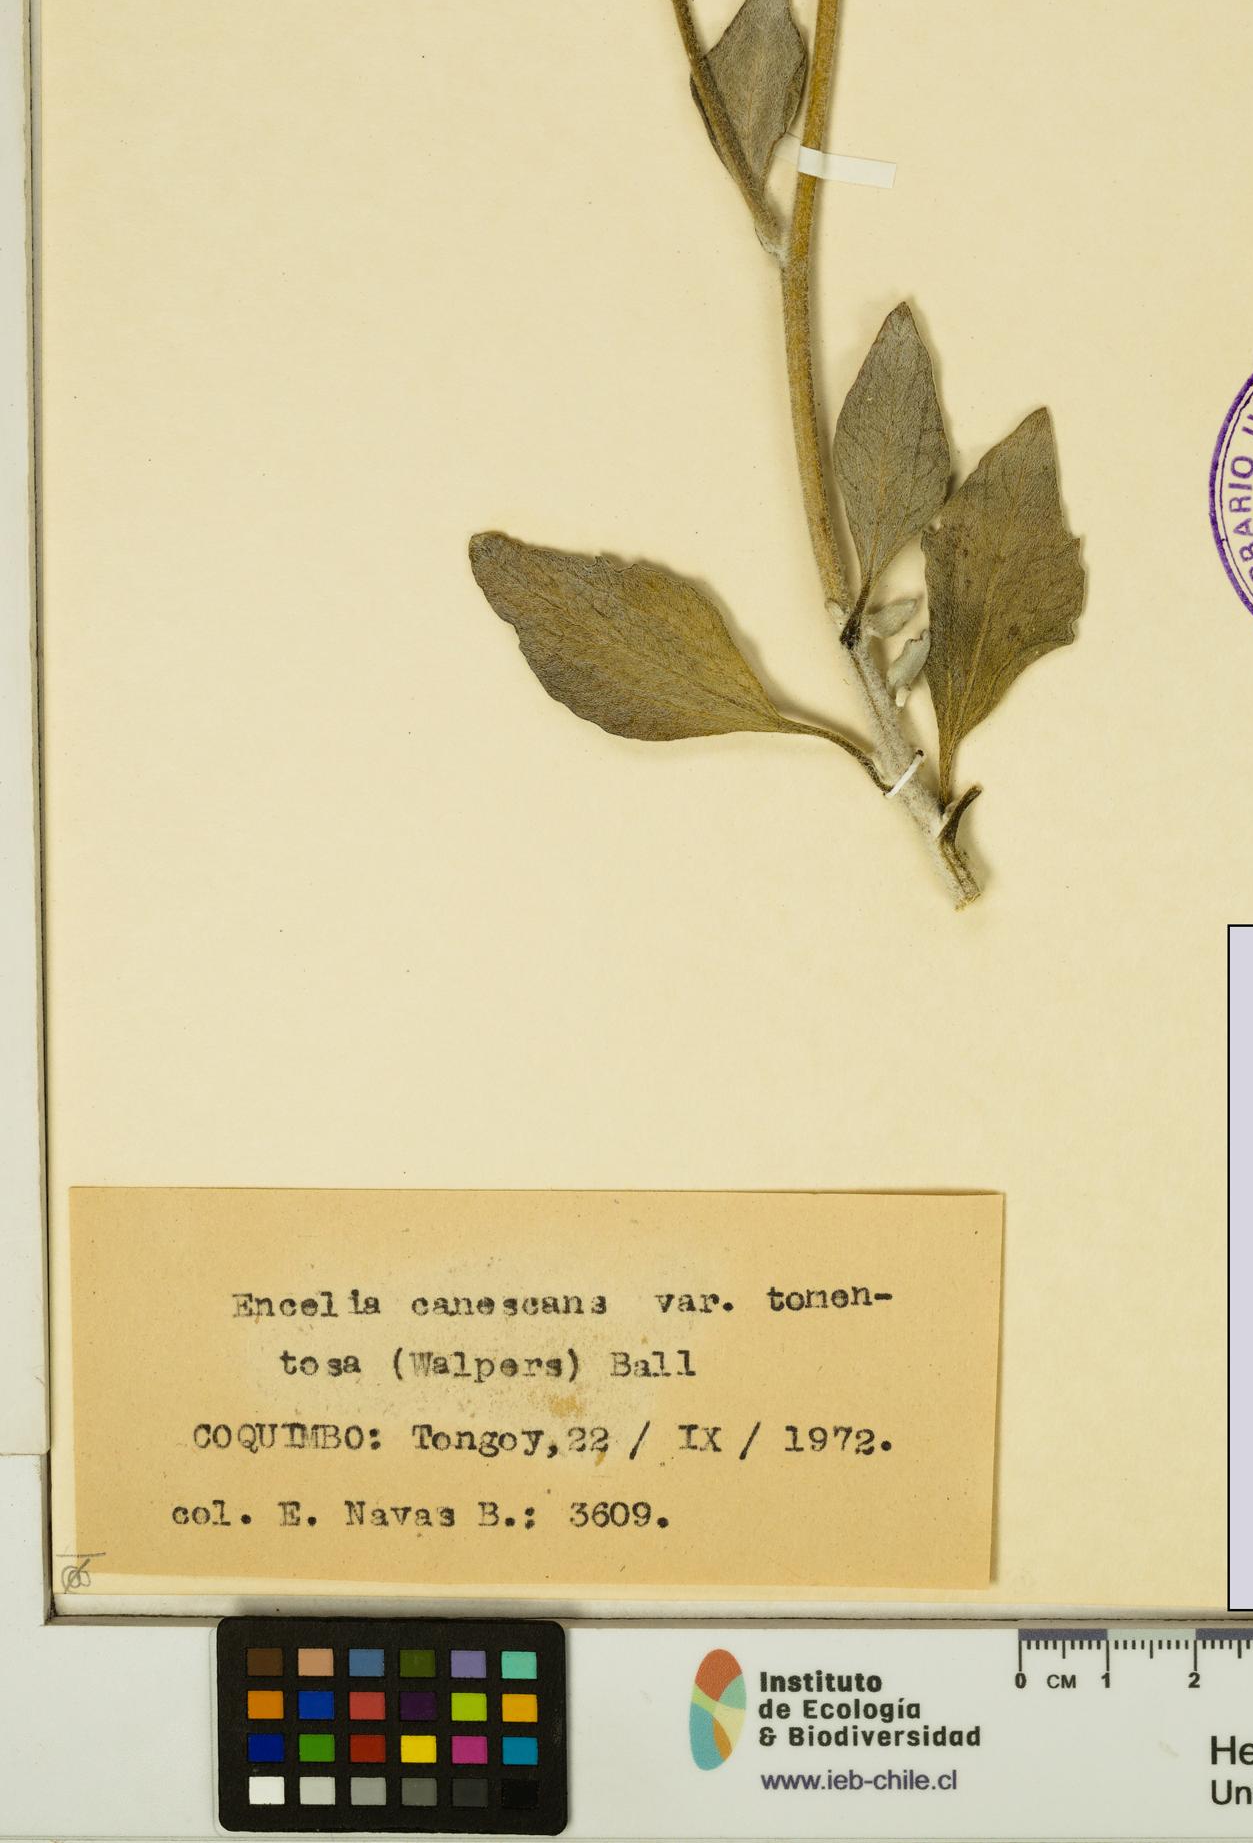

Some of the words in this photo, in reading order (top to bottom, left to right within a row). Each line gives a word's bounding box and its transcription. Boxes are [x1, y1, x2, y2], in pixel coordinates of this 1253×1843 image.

[232, 1289, 380, 1317] Encelia
[655, 1294, 734, 1313] var.
[280, 1350, 361, 1377] tosa
[393, 1348, 578, 1383] (Walpers)
[611, 1350, 696, 1377] Ball
[194, 1422, 381, 1454] COQUIMBO:
[678, 1424, 722, 1452] IX
[785, 1425, 891, 1455] 1972.
[172, 1500, 251, 1526] col.
[278, 1501, 316, 1526] E.
[344, 1500, 455, 1527] Navas
[478, 1502, 535, 1530] B.:
[570, 1502, 669, 1528] 3609.
[760, 1670, 882, 1692] Instituto
[1015, 1673, 1027, 1689] 0
[1047, 1675, 1076, 1689] CM
[1101, 1670, 1110, 1688] 1
[1189, 1672, 1200, 1688] 2
[759, 1699, 790, 1719] de
[803, 1698, 920, 1723] Ecología
[759, 1727, 777, 1746] &
[789, 1725, 980, 1747] Biodiversidad
[761, 1769, 956, 1790] www.ieb-chile.cl
